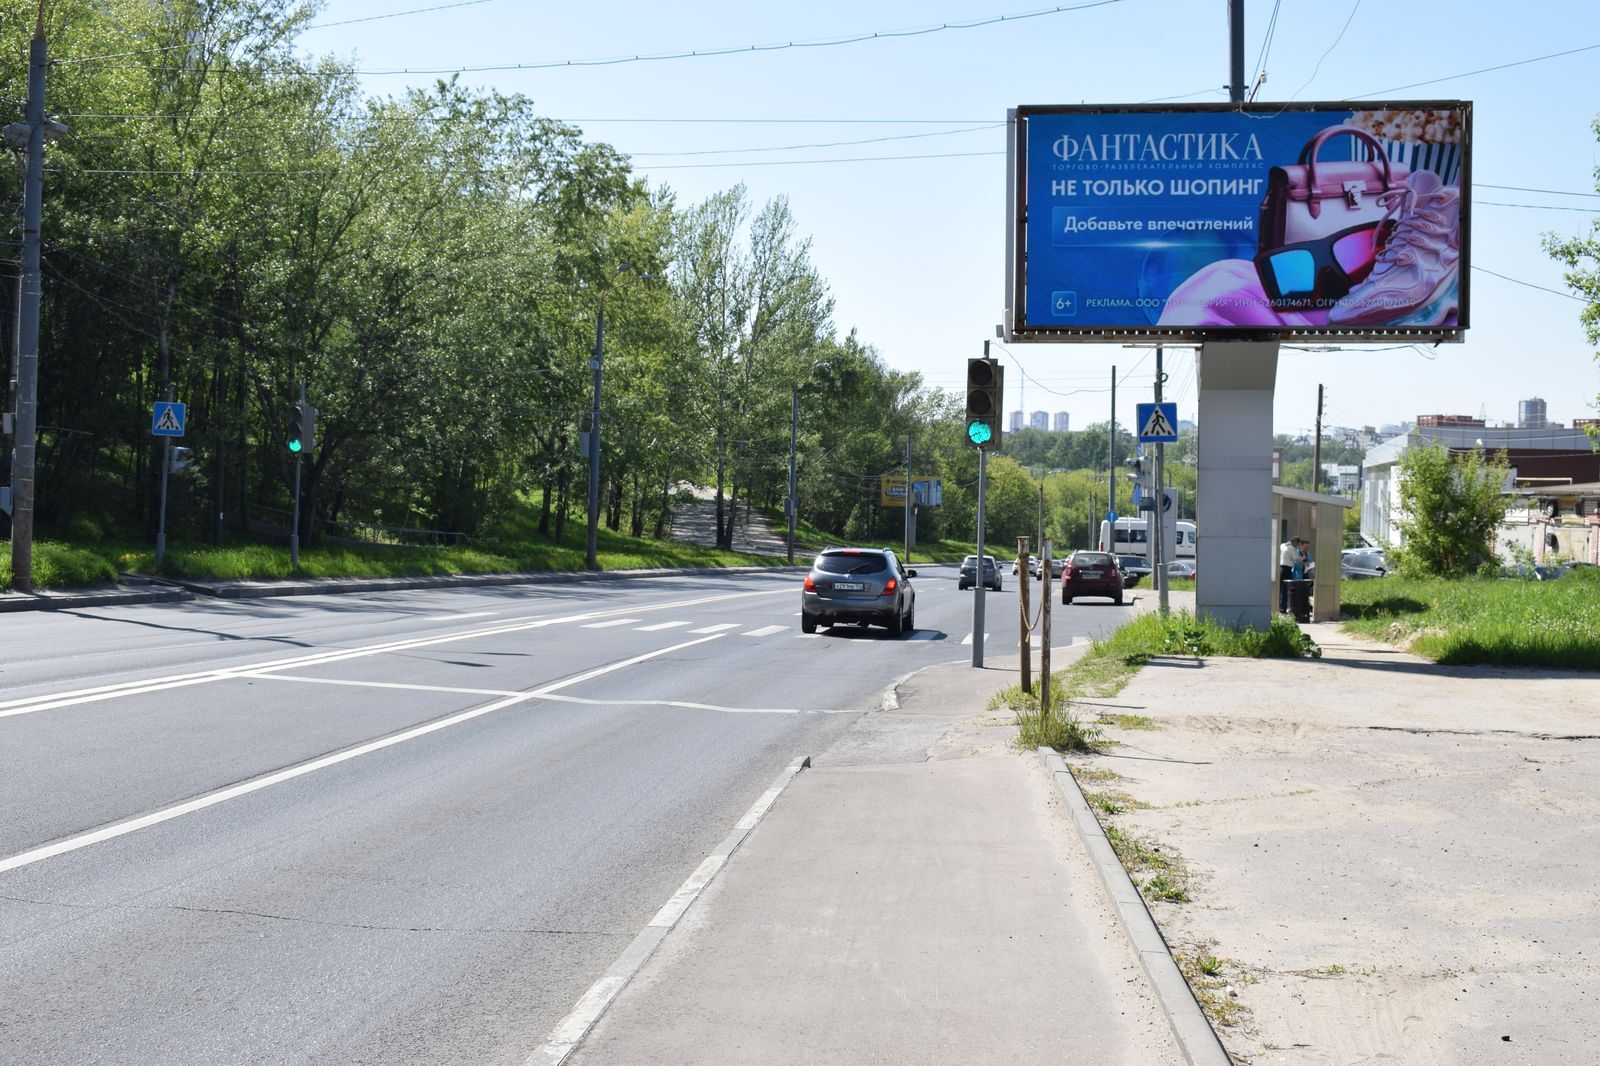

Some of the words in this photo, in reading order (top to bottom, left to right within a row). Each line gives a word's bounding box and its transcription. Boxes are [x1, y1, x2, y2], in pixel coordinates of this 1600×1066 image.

[1052, 133, 1264, 161] ФАНТАСТИКА
[1053, 162, 1203, 171] ТОРГОВО-РАЗВЛЕКАТЕЛЬНЫЙ
[1051, 179, 1077, 196] НЕ
[1082, 179, 1165, 196] ТОЛЬКО
[1170, 178, 1264, 195] ШОПИНГ
[1064, 216, 1143, 233] Добавьте
[1148, 216, 1253, 231] впечатлений
[1056, 298, 1072, 310] 6+
[1086, 298, 1134, 307] РЕКЛАМА.
[1135, 298, 1160, 307] ООО
